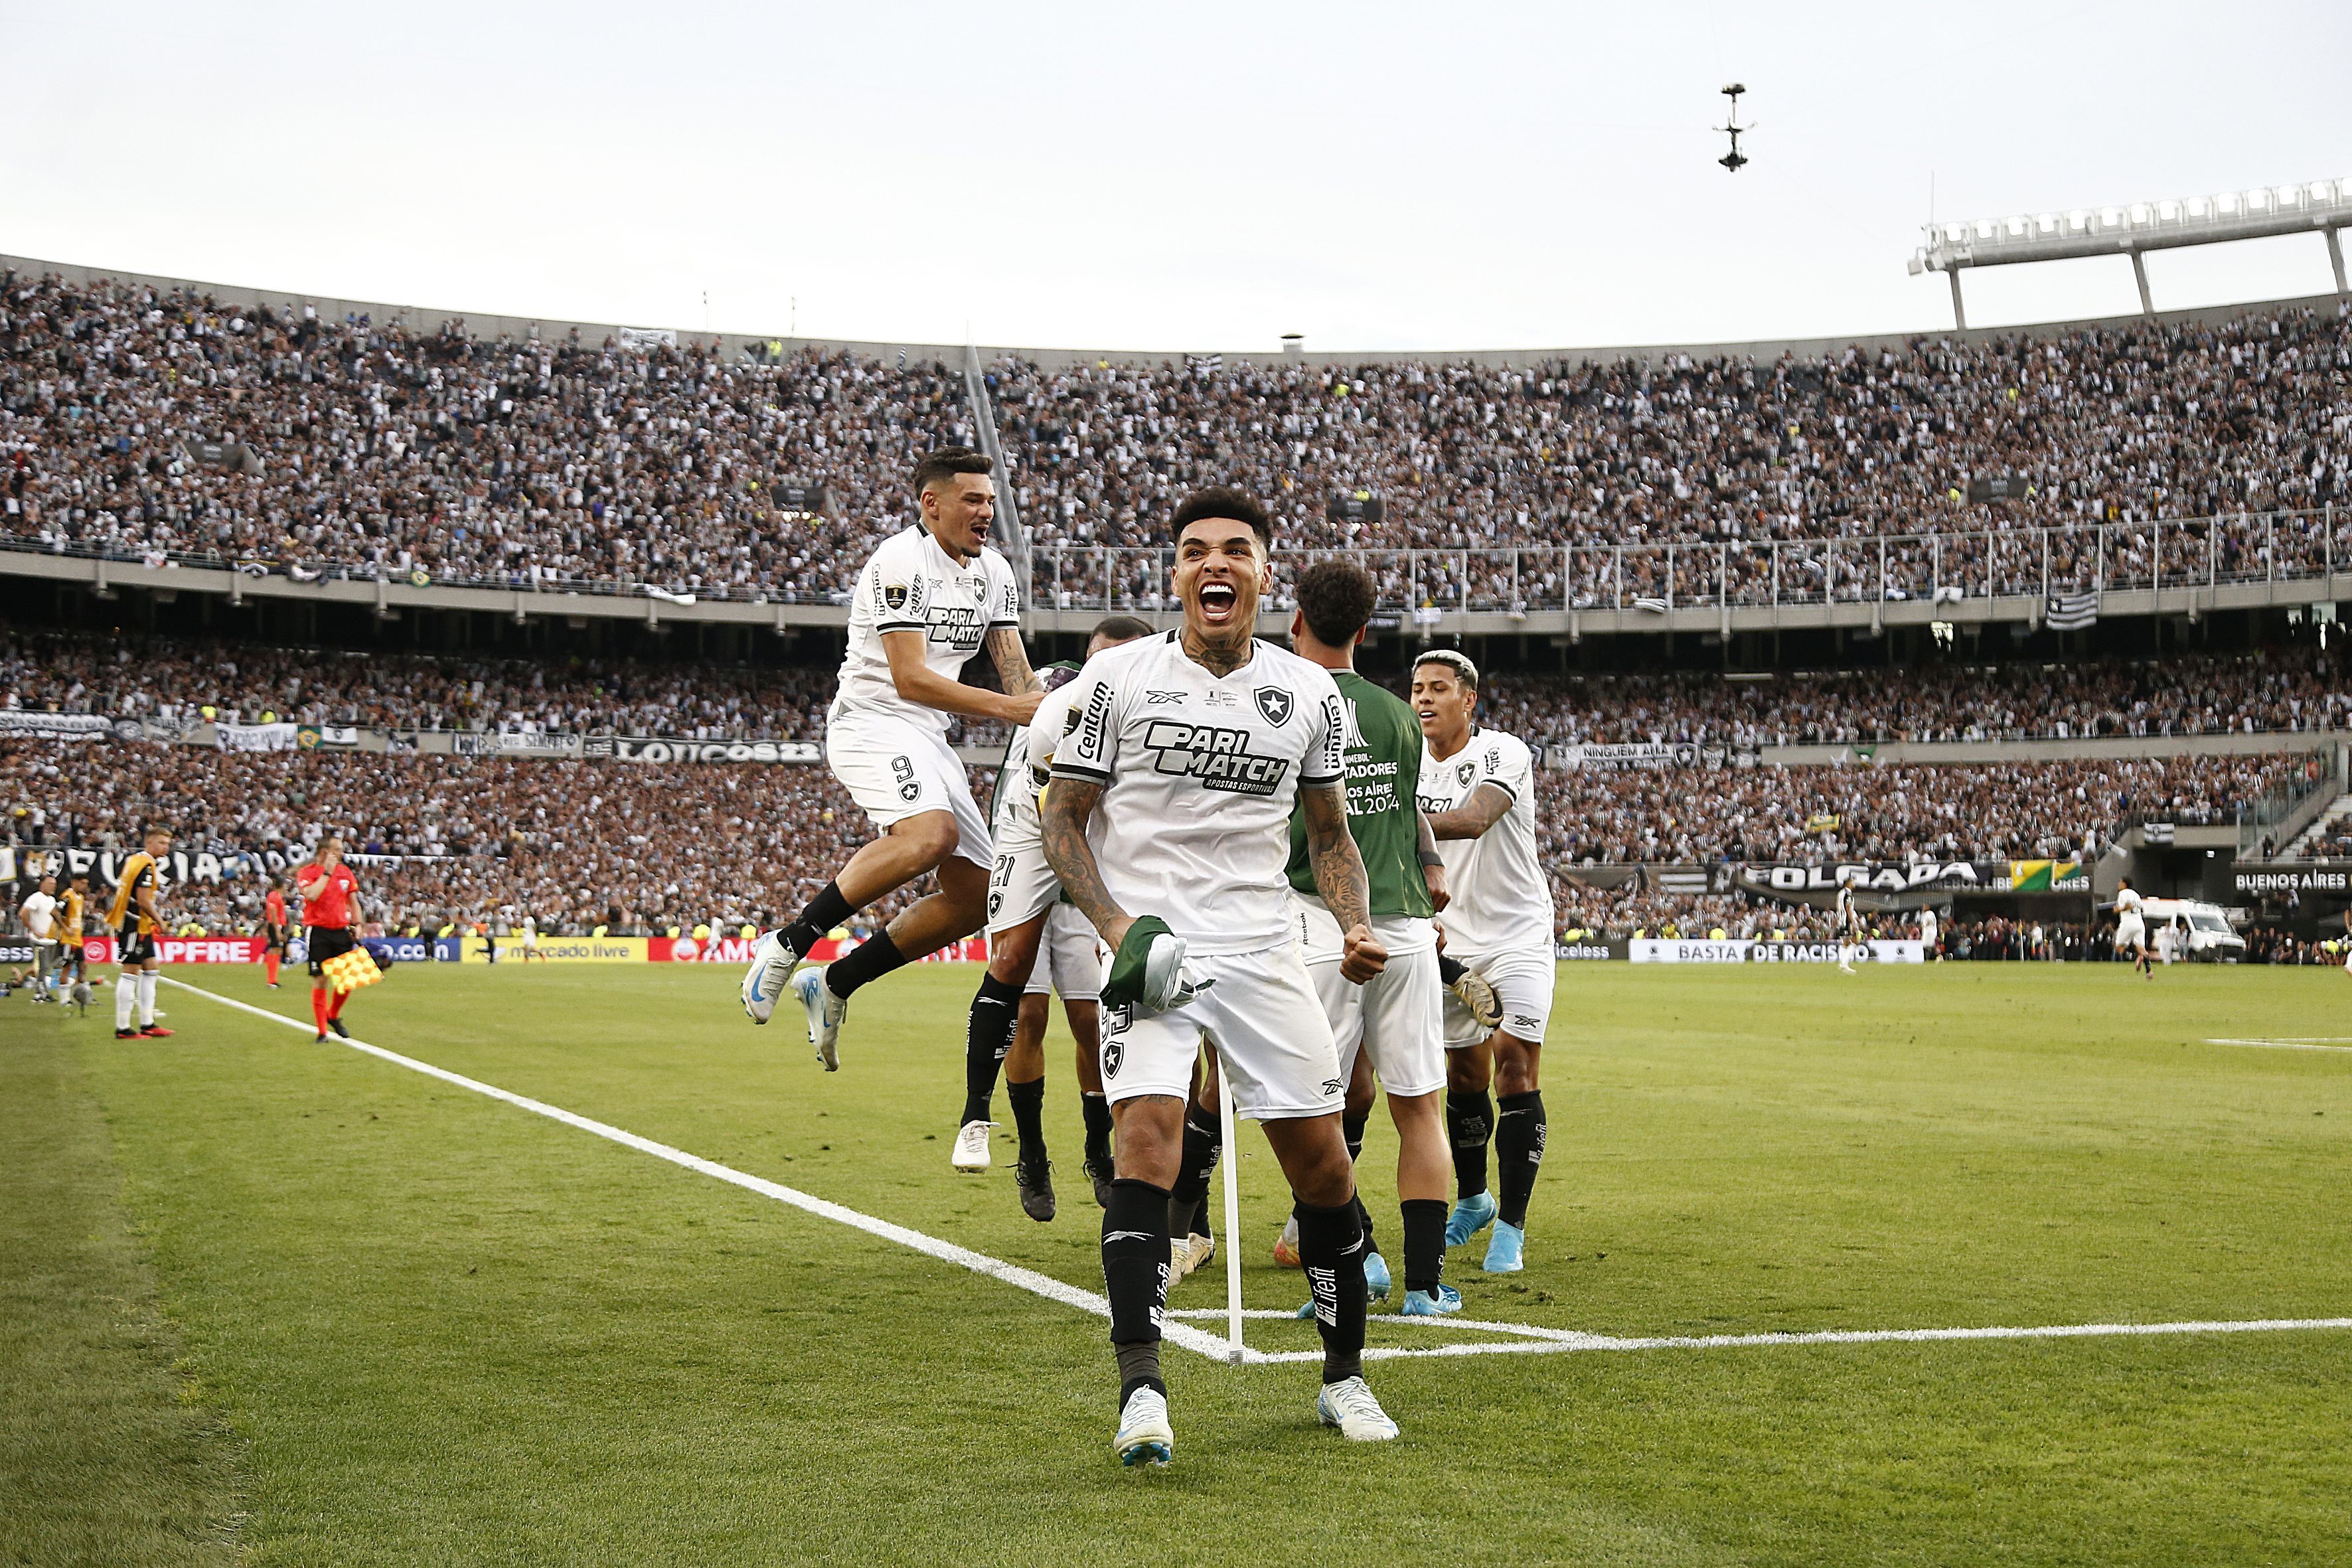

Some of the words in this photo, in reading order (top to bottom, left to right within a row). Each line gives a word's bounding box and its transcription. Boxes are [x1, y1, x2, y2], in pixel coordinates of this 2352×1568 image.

[927, 608, 973, 625] PARI
[1077, 681, 1109, 759] Centrum
[1147, 725, 1247, 754] PARI
[1328, 694, 1342, 769] Centrum
[892, 755, 913, 783] 9
[1158, 749, 1286, 783] MATCH
[1345, 761, 1397, 779] TADORES
[1206, 779, 1238, 789] APOSTAS
[1238, 782, 1275, 793] ESPORTIVAS
[990, 854, 1015, 888] 21
[2236, 873, 2299, 891] BUENOS
[117, 941, 251, 963] APFRE
[510, 943, 589, 958] mercado
[592, 943, 630, 958] livre
[1555, 941, 1609, 959] iceless
[1679, 945, 1739, 959] BASTA
[1752, 944, 1780, 962] DE
[1308, 1266, 1337, 1314] Lifefit
